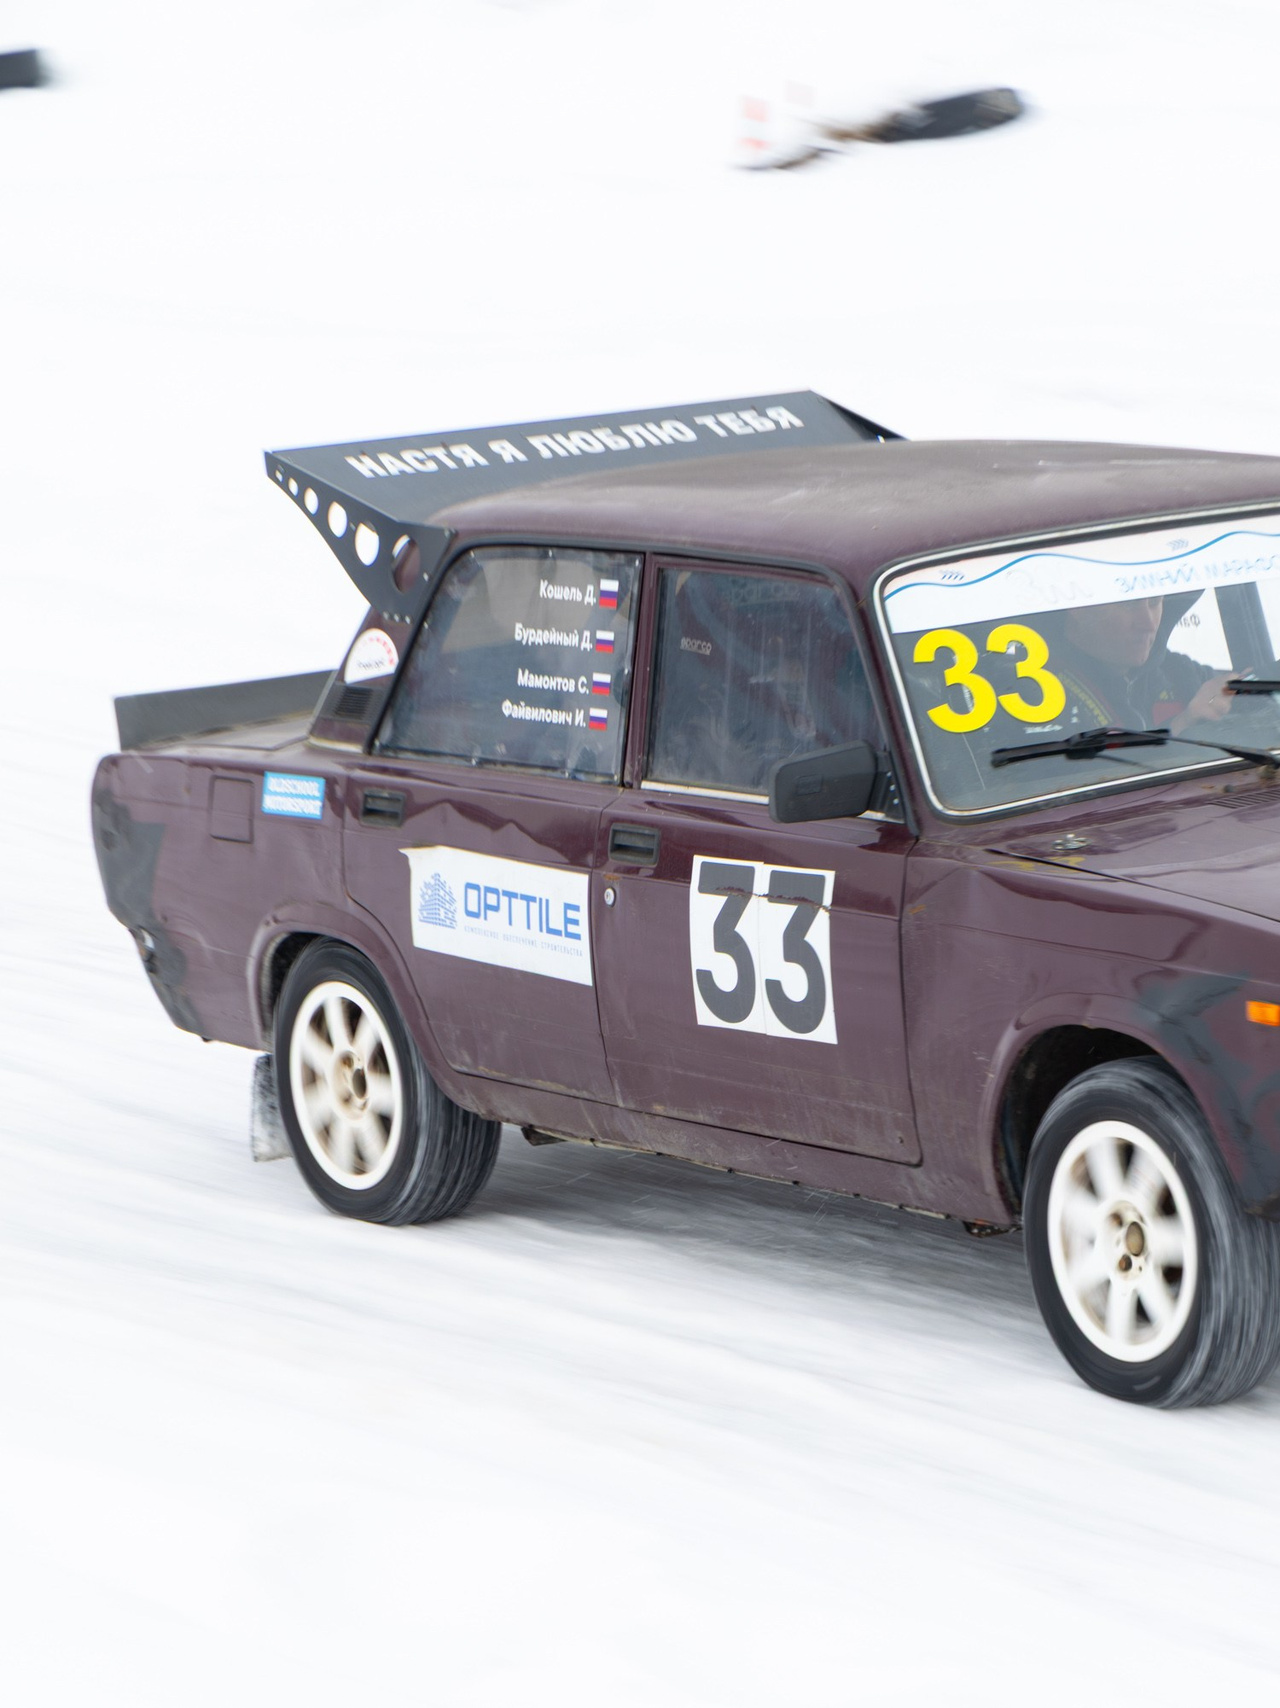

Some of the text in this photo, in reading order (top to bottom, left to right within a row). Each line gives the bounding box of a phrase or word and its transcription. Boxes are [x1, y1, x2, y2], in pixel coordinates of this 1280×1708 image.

[344, 405, 805, 478] НАСТЯ Я ЛЮБЛЮ ТЕБЯ
[539, 579, 597, 606] Кошель Д.
[514, 622, 593, 652] Бурдейный Д.
[517, 667, 590, 696] Мамонтов С.
[913, 624, 1066, 733] 33
[501, 699, 586, 728] Файвилович И.
[464, 881, 582, 940] OPTTILE
[696, 861, 826, 1034] 33
